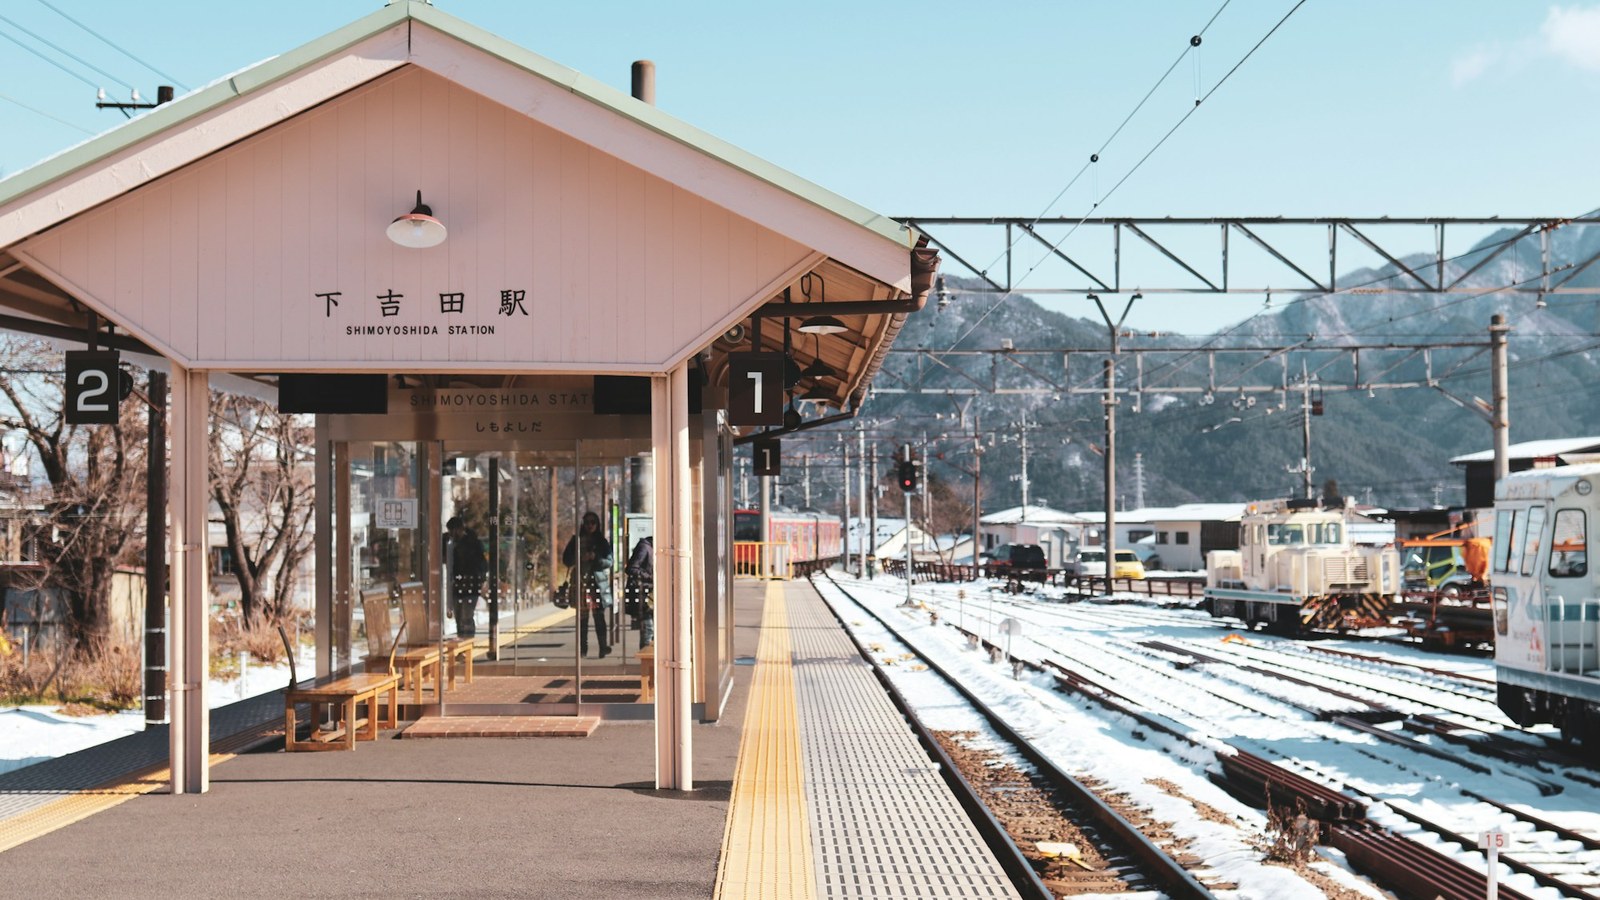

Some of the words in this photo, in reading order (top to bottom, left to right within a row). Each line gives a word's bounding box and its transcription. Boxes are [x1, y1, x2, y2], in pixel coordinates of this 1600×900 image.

[315, 288, 529, 318] 下吉田駅
[346, 325, 438, 335] SHIMOYOSHIDA
[448, 325, 495, 335] STATION
[78, 369, 109, 412] 2
[746, 371, 763, 414] 1
[410, 394, 540, 406] SHIMOYOSHIDA
[550, 394, 594, 406] STAT
[476, 421, 542, 433] しもよしだ
[762, 448, 771, 470] 1
[1486, 834, 1504, 847] 15
